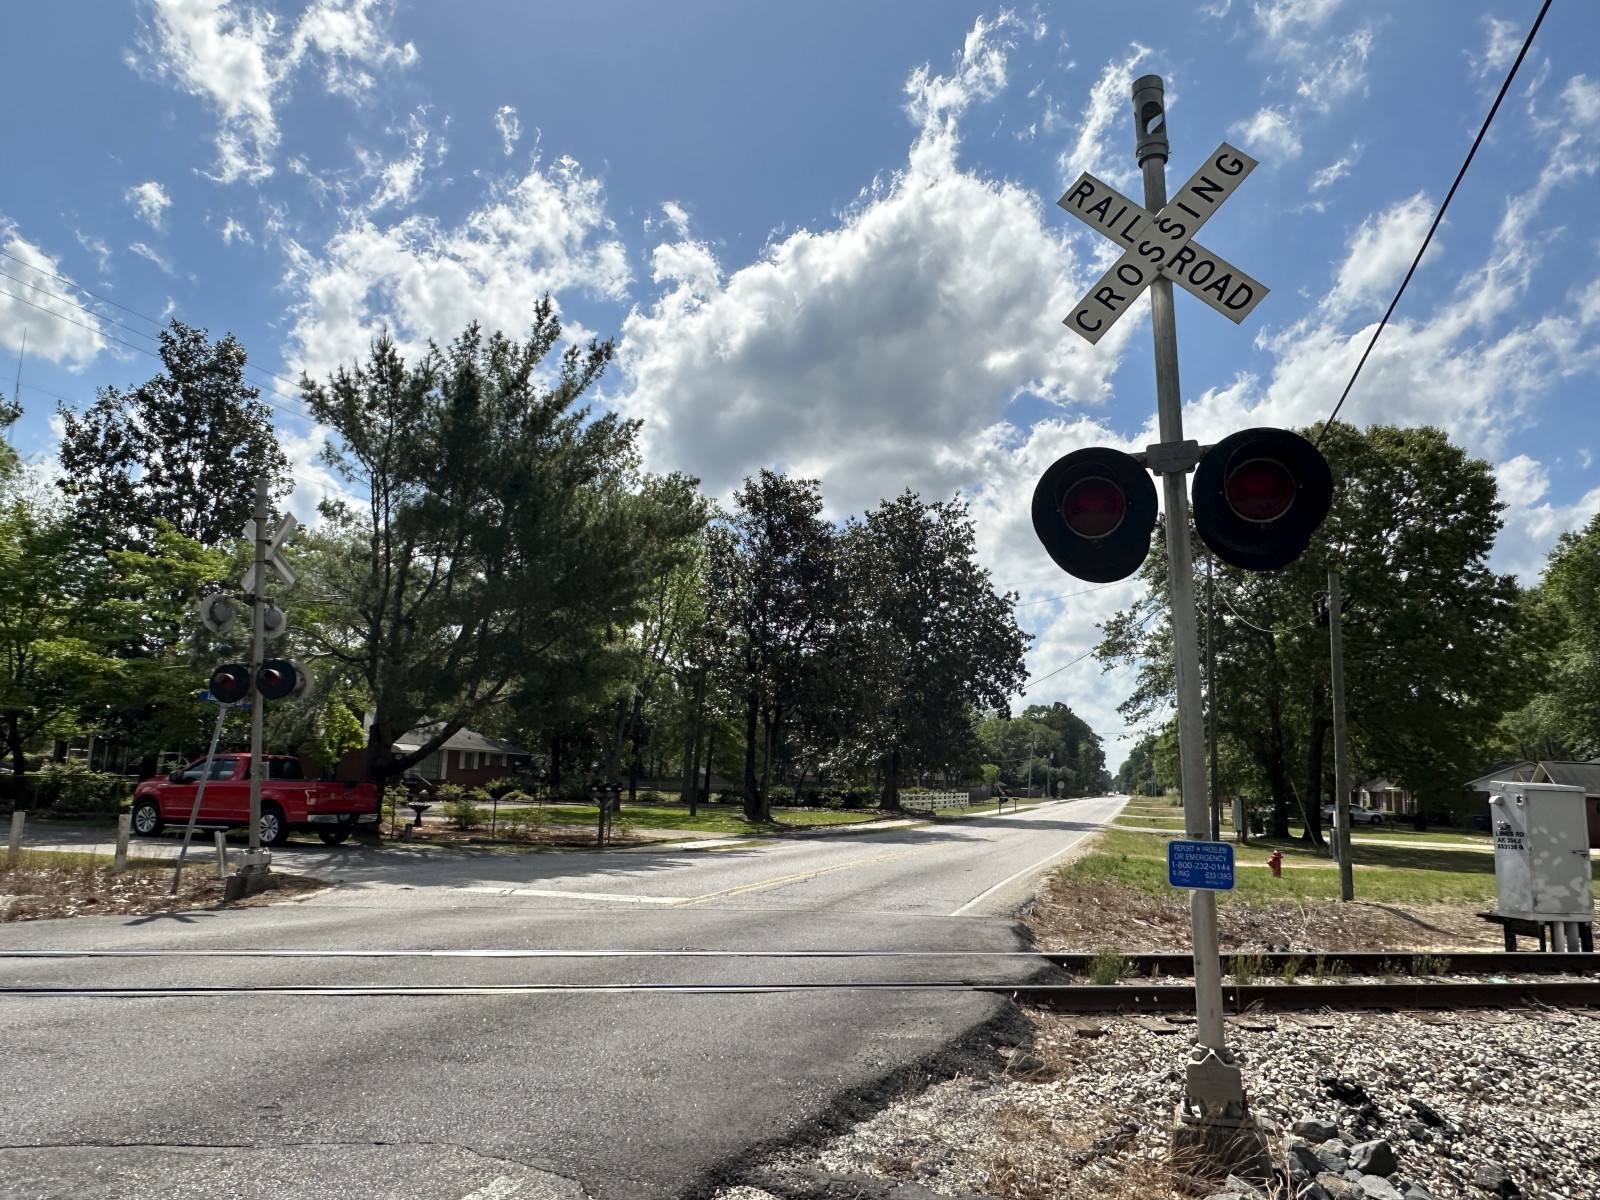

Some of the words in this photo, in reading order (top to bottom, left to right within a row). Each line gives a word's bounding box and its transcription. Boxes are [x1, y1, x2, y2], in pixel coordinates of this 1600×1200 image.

[1075, 153, 1244, 332] CROSSING
[1173, 844, 1195, 852] REPORT
[1201, 845, 1228, 854] PROBLEM
[1185, 853, 1226, 862] EMERGENCY
